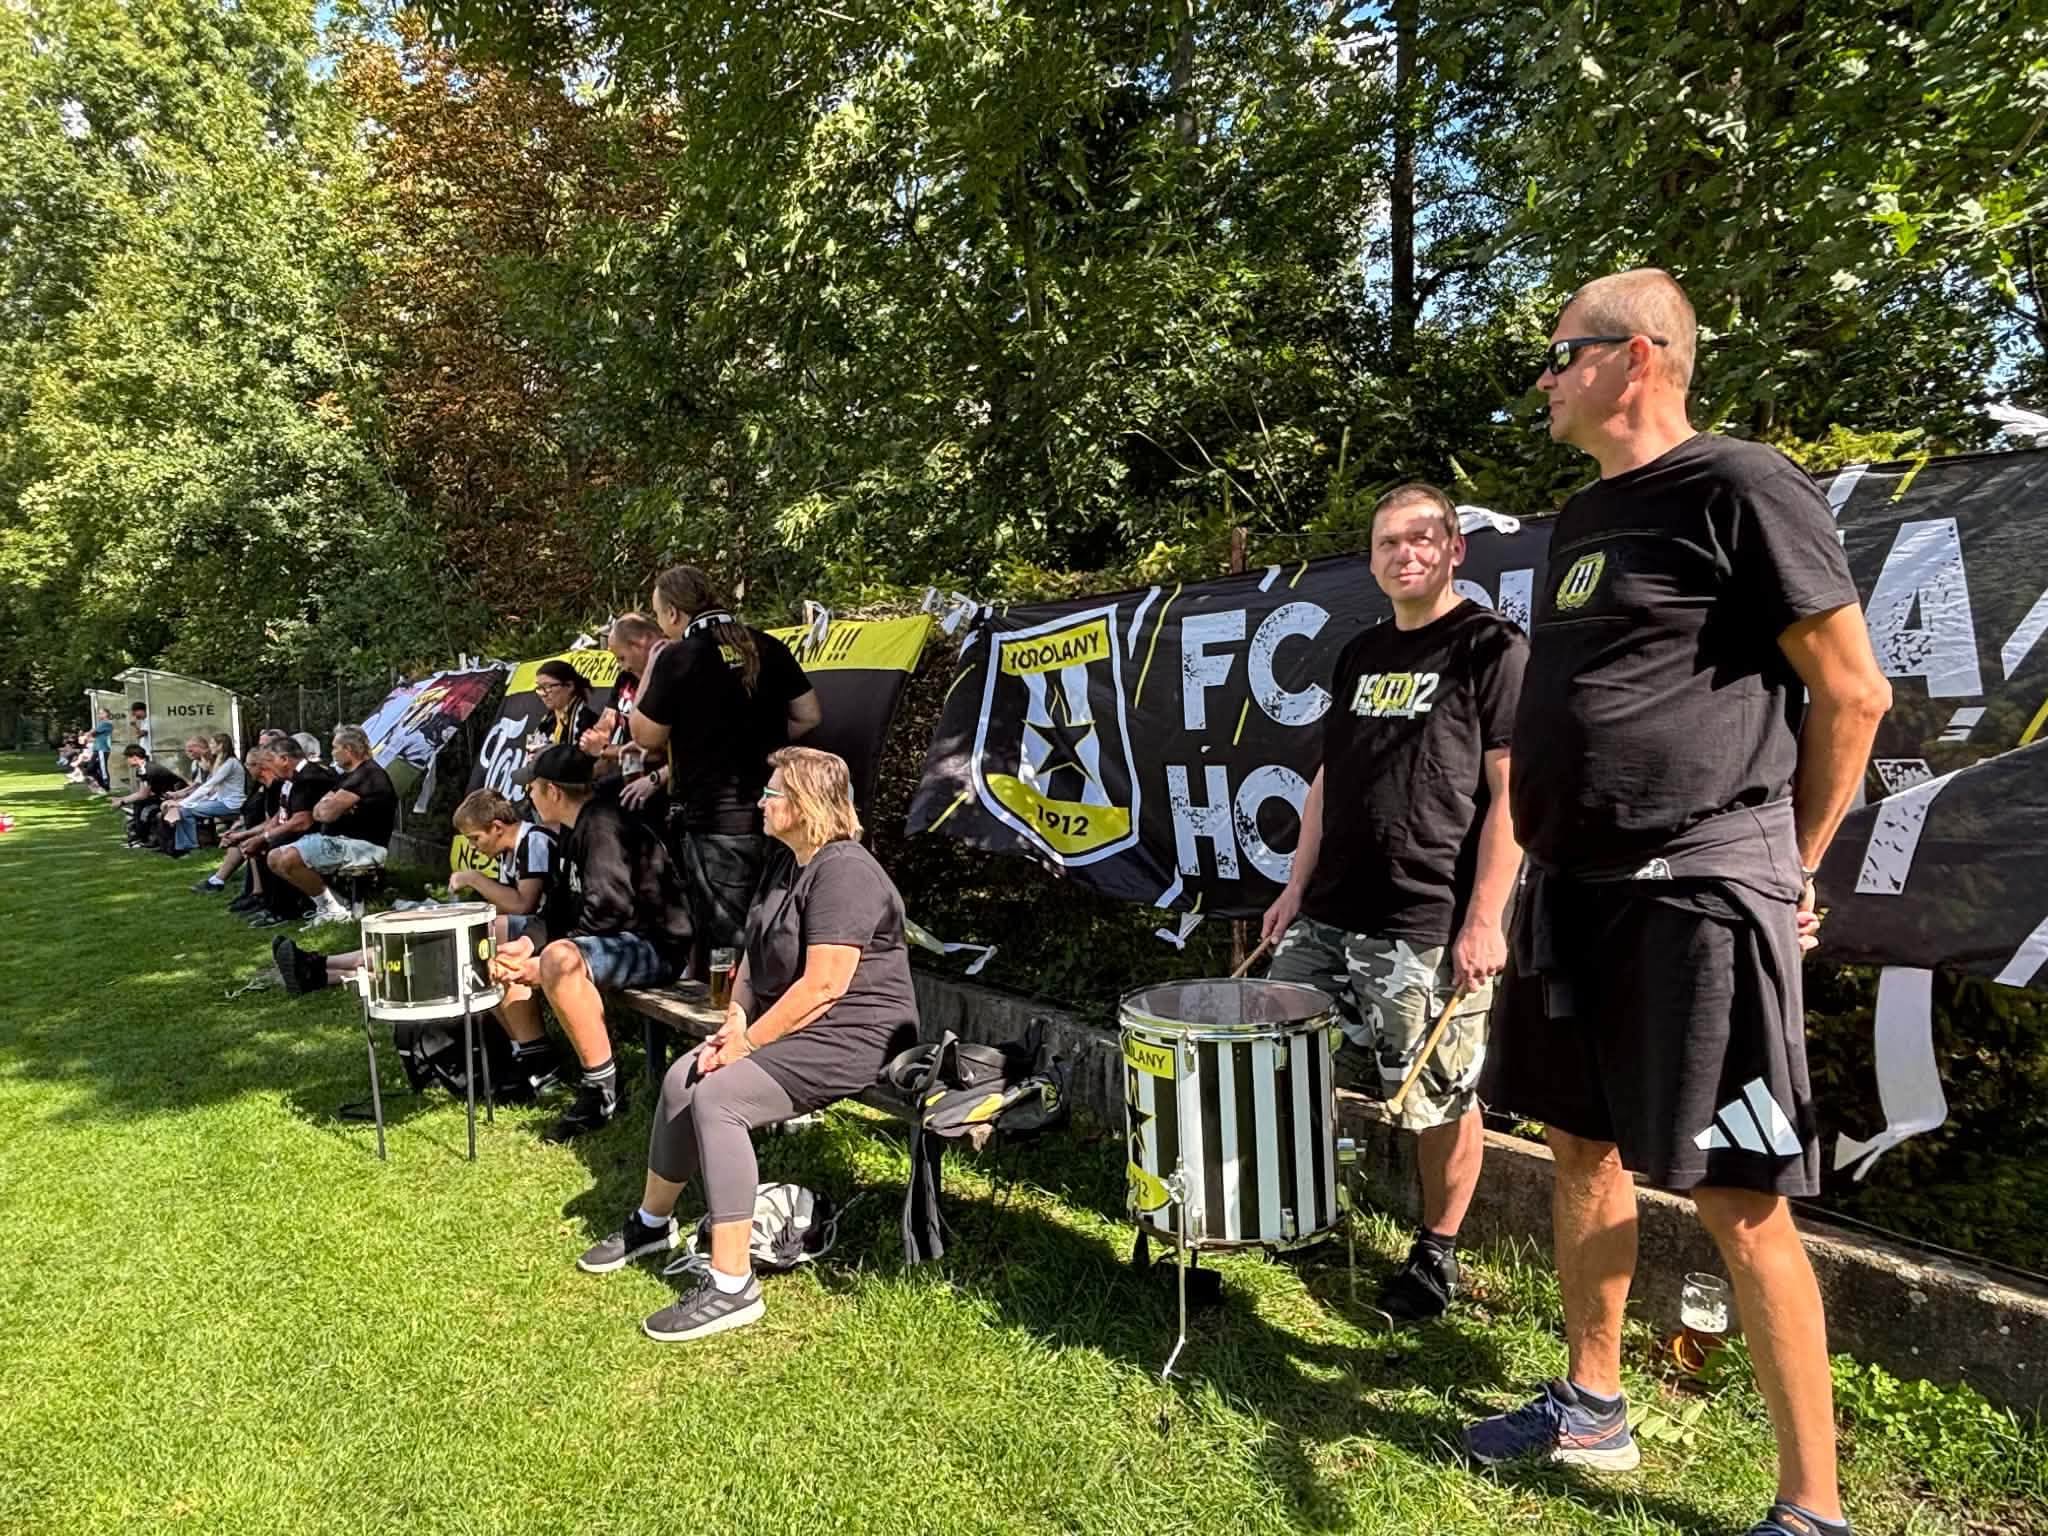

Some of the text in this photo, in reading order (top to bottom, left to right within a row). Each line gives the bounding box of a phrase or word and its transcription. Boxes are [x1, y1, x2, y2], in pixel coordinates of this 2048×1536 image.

[1181, 601, 1333, 730] FC
[167, 702, 216, 717] HOSTÉ
[1037, 803, 1089, 837] 1912
